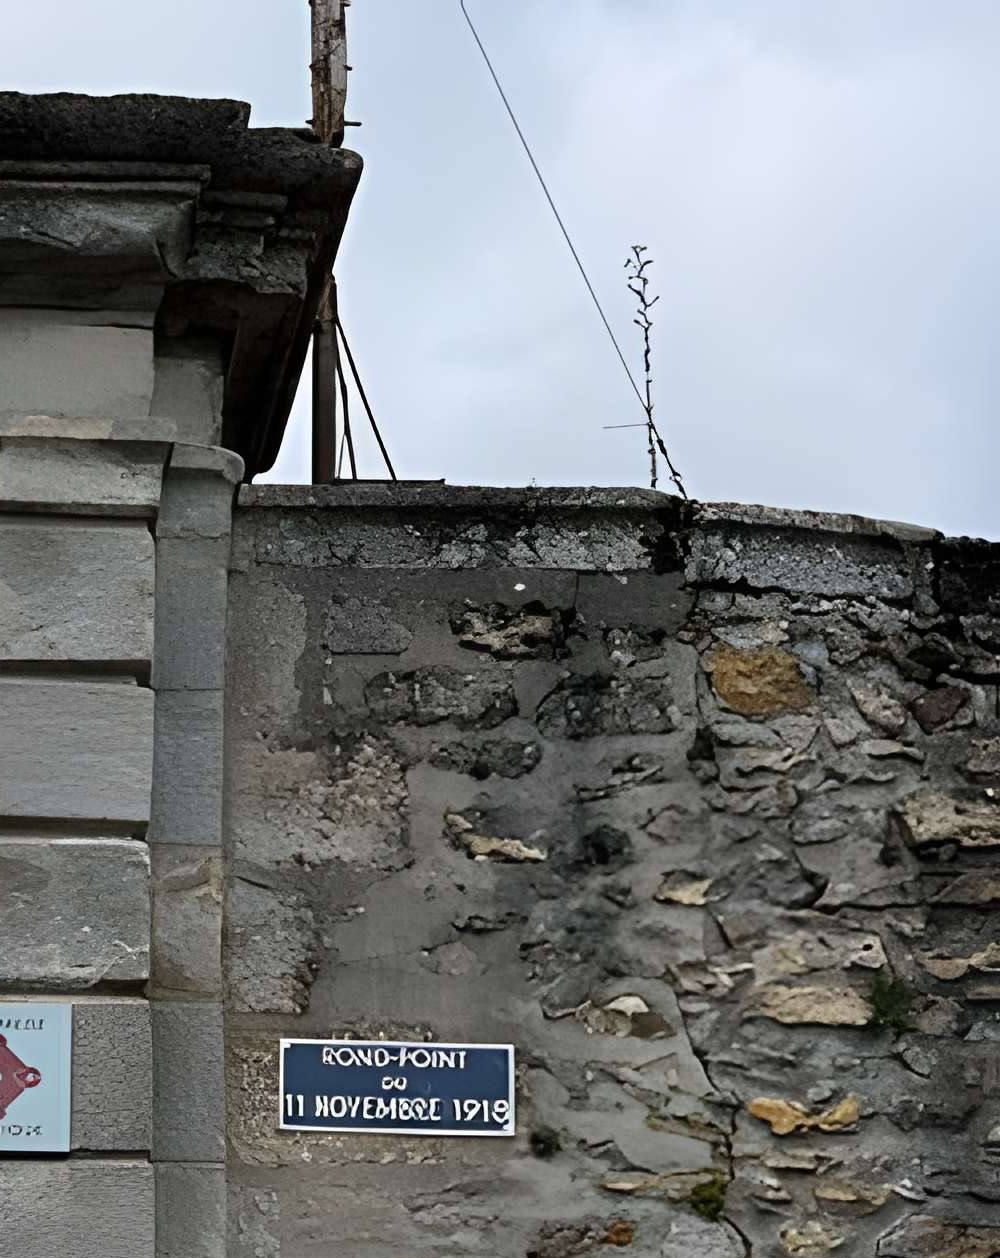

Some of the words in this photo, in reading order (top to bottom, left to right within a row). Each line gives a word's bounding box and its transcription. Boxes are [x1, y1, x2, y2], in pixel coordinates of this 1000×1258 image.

[286, 1094, 304, 1117] 11
[315, 1095, 441, 1121] NOVEMBRE
[453, 1099, 510, 1124] 1918
